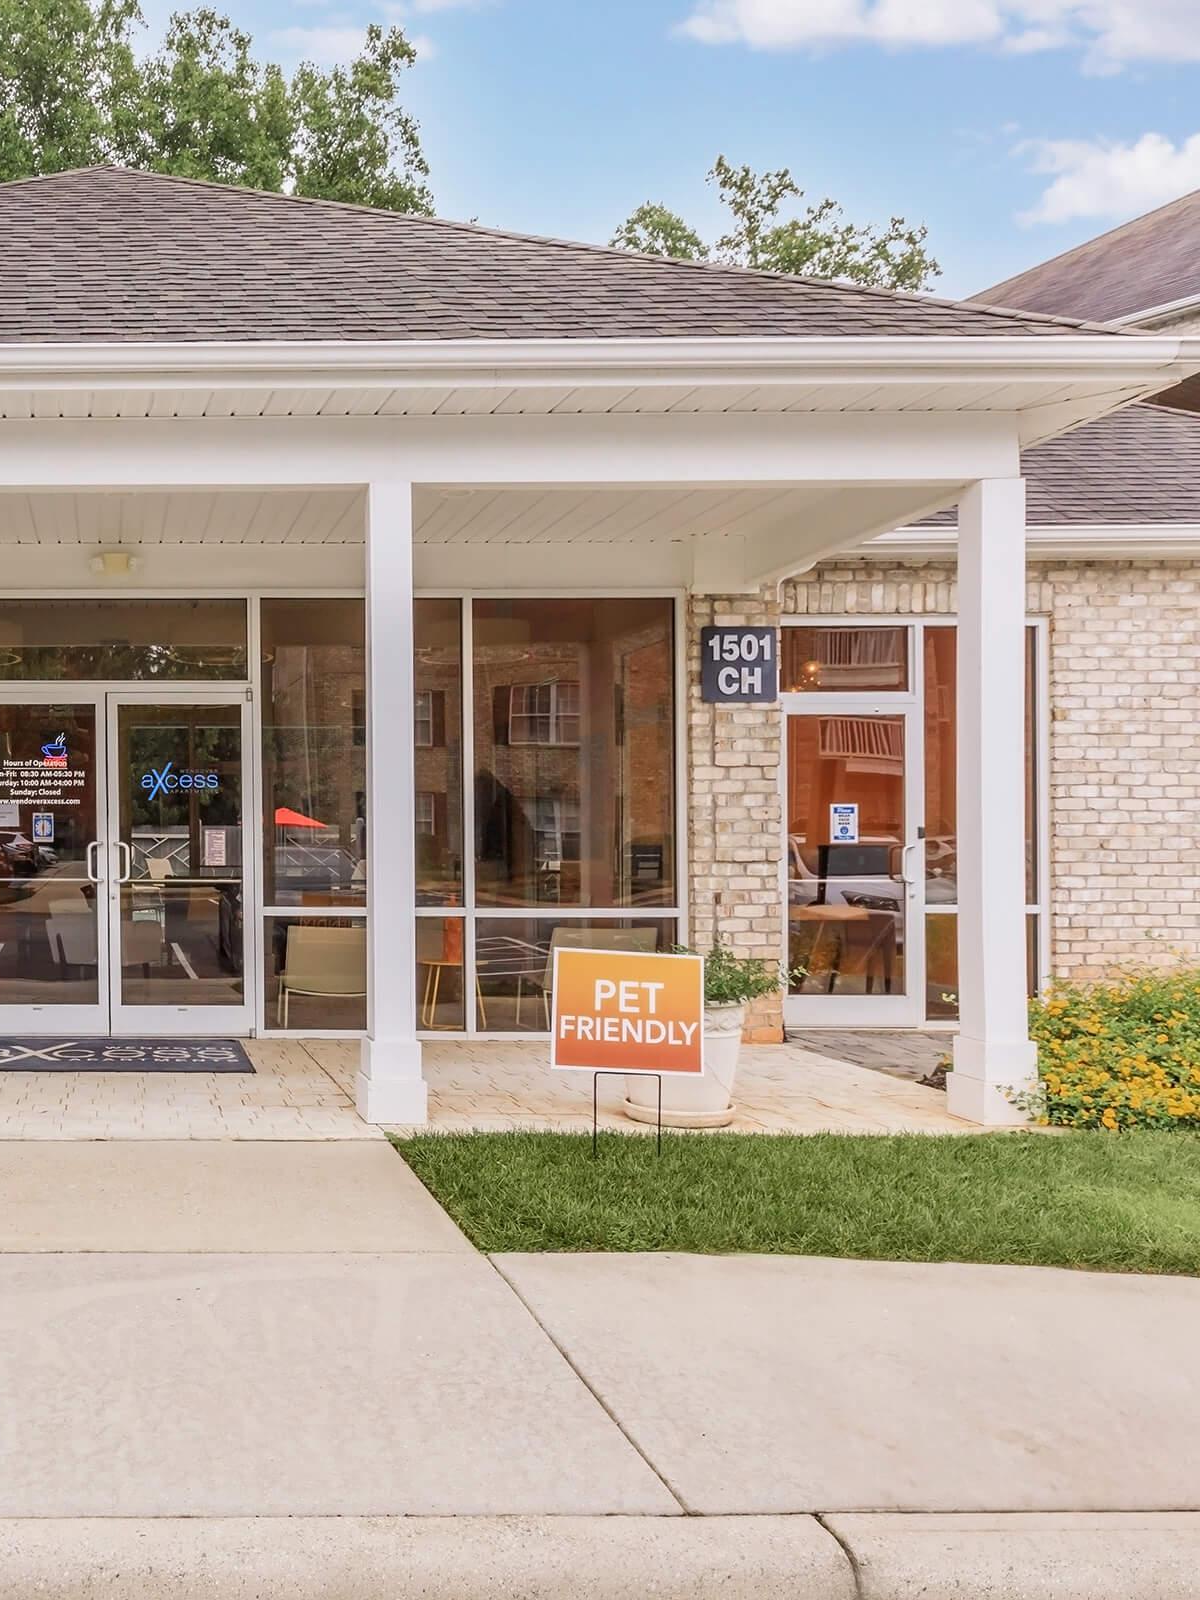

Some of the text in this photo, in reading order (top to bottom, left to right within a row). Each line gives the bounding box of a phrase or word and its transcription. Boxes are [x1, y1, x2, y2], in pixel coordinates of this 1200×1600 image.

[708, 634, 771, 661] 1501
[718, 666, 762, 695] CH
[3, 759, 68, 768] Hours of Operation
[10, 789, 38, 797] Sunday:
[594, 979, 664, 1014] PET
[560, 1014, 699, 1046] FRIENDLY
